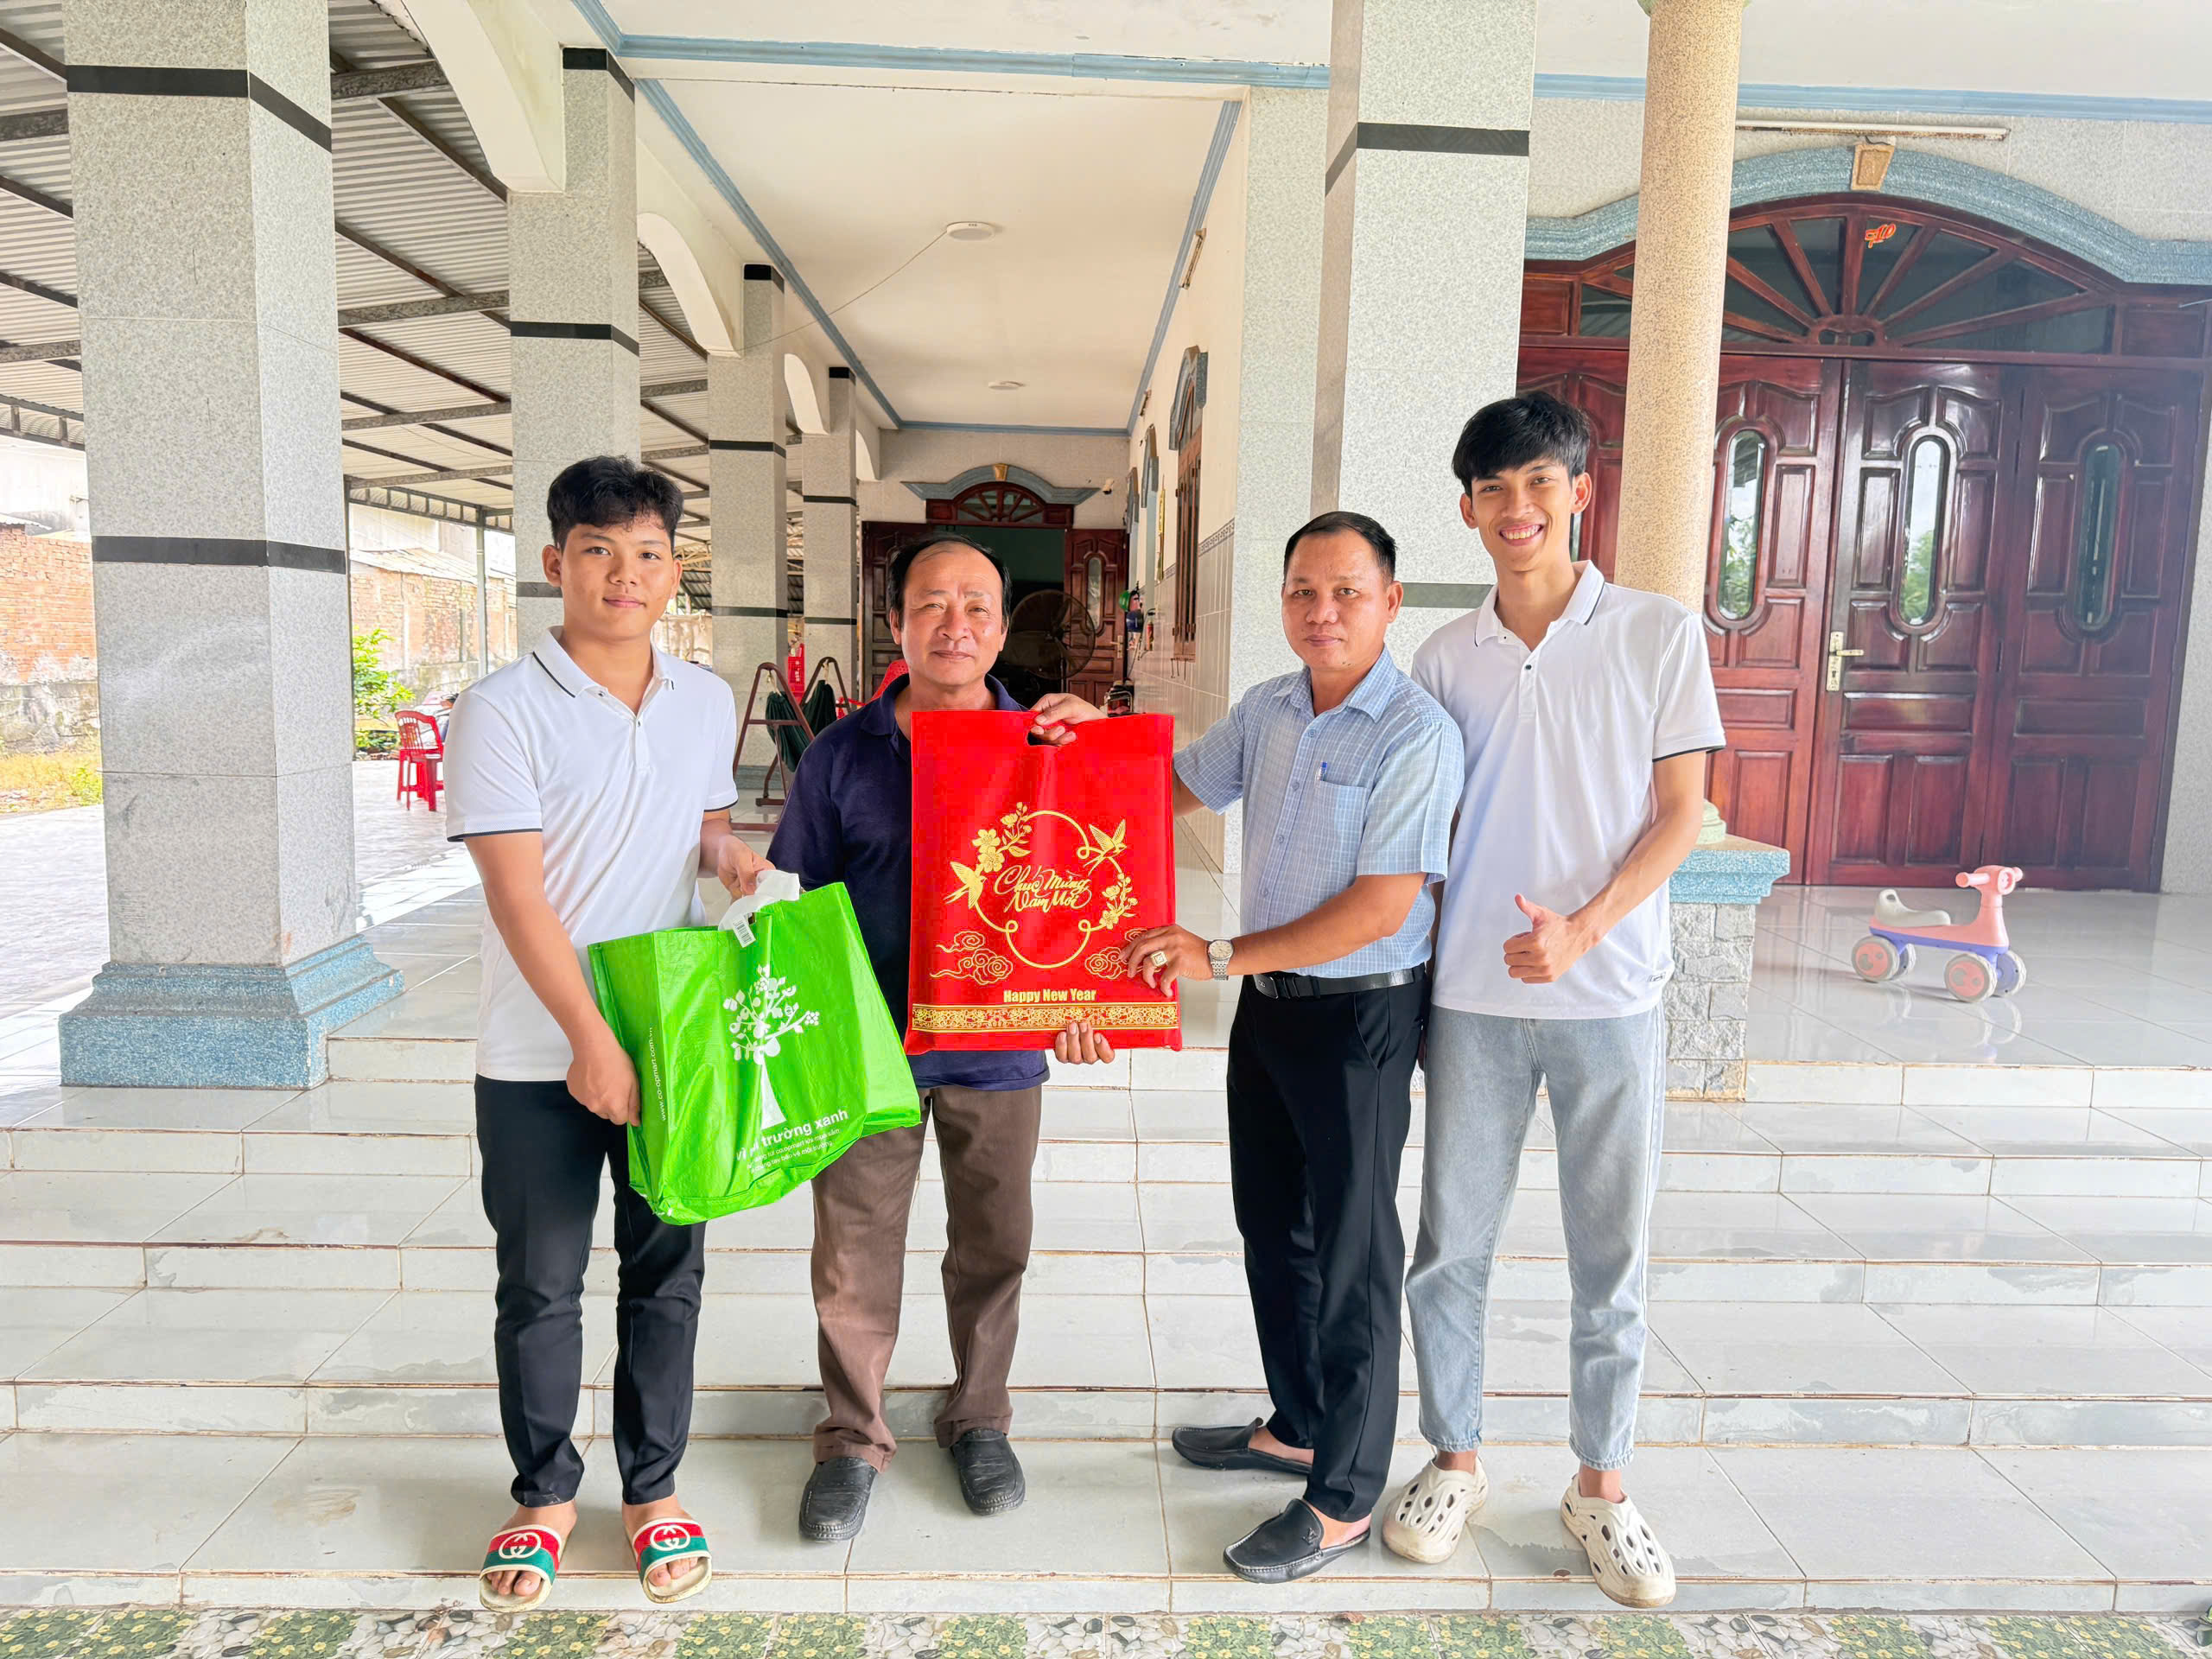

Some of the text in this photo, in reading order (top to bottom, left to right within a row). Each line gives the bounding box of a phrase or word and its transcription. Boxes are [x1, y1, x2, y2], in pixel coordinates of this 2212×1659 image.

[1003, 988, 1096, 1003] Happy New Year
[762, 1123, 811, 1147] trường
[816, 1109, 849, 1128] xanh
